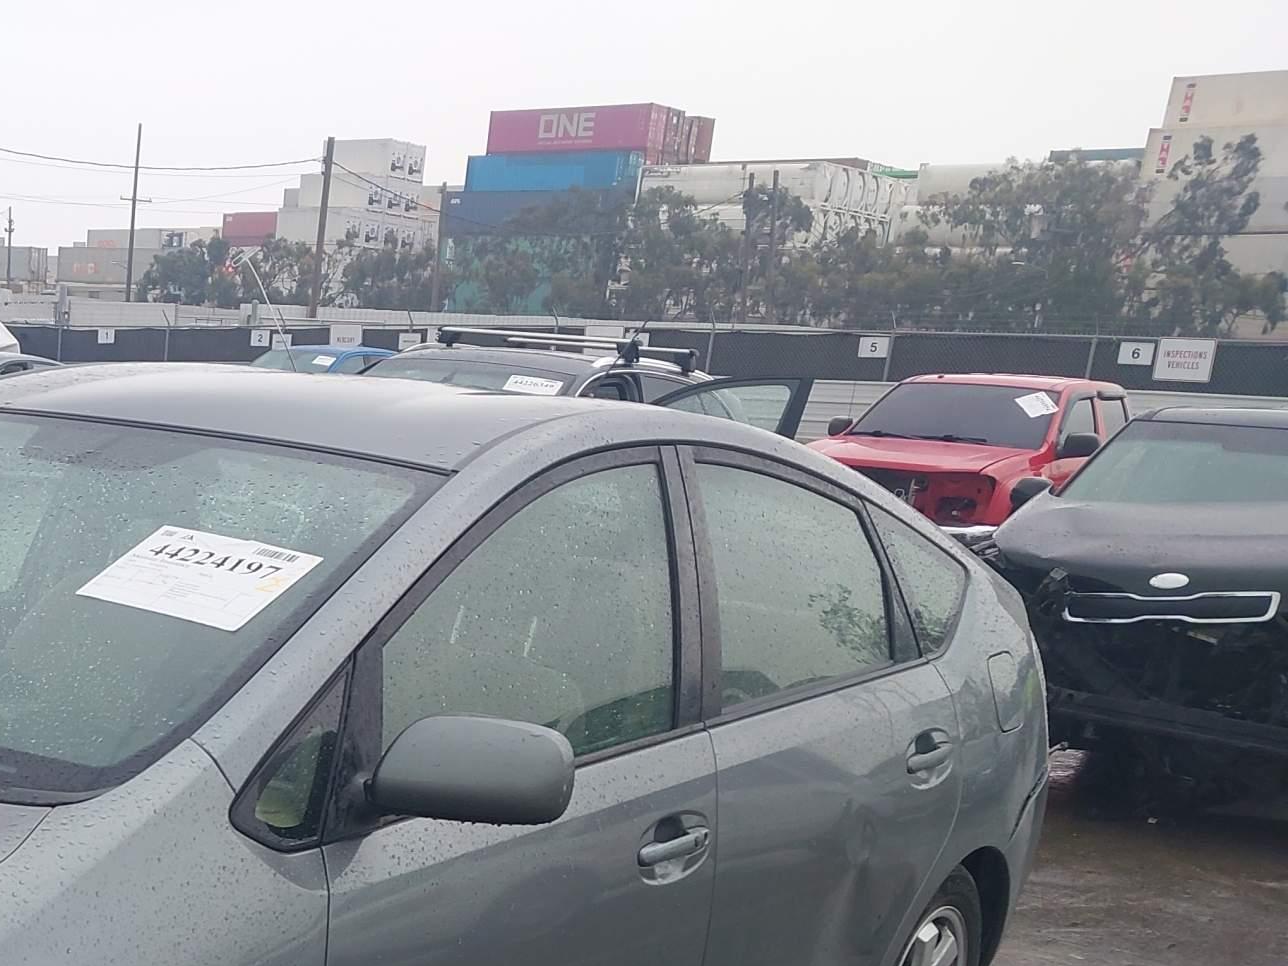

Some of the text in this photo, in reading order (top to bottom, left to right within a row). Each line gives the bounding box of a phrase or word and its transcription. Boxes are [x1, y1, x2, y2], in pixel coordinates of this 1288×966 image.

[538, 112, 596, 138] ONE
[257, 334, 263, 343] 2
[870, 342, 878, 353] 5
[1131, 347, 1141, 359] 6
[1163, 350, 1208, 360] INSPECTIONS
[1167, 361, 1200, 370] VEHICLES
[149, 543, 283, 579] 44224197
